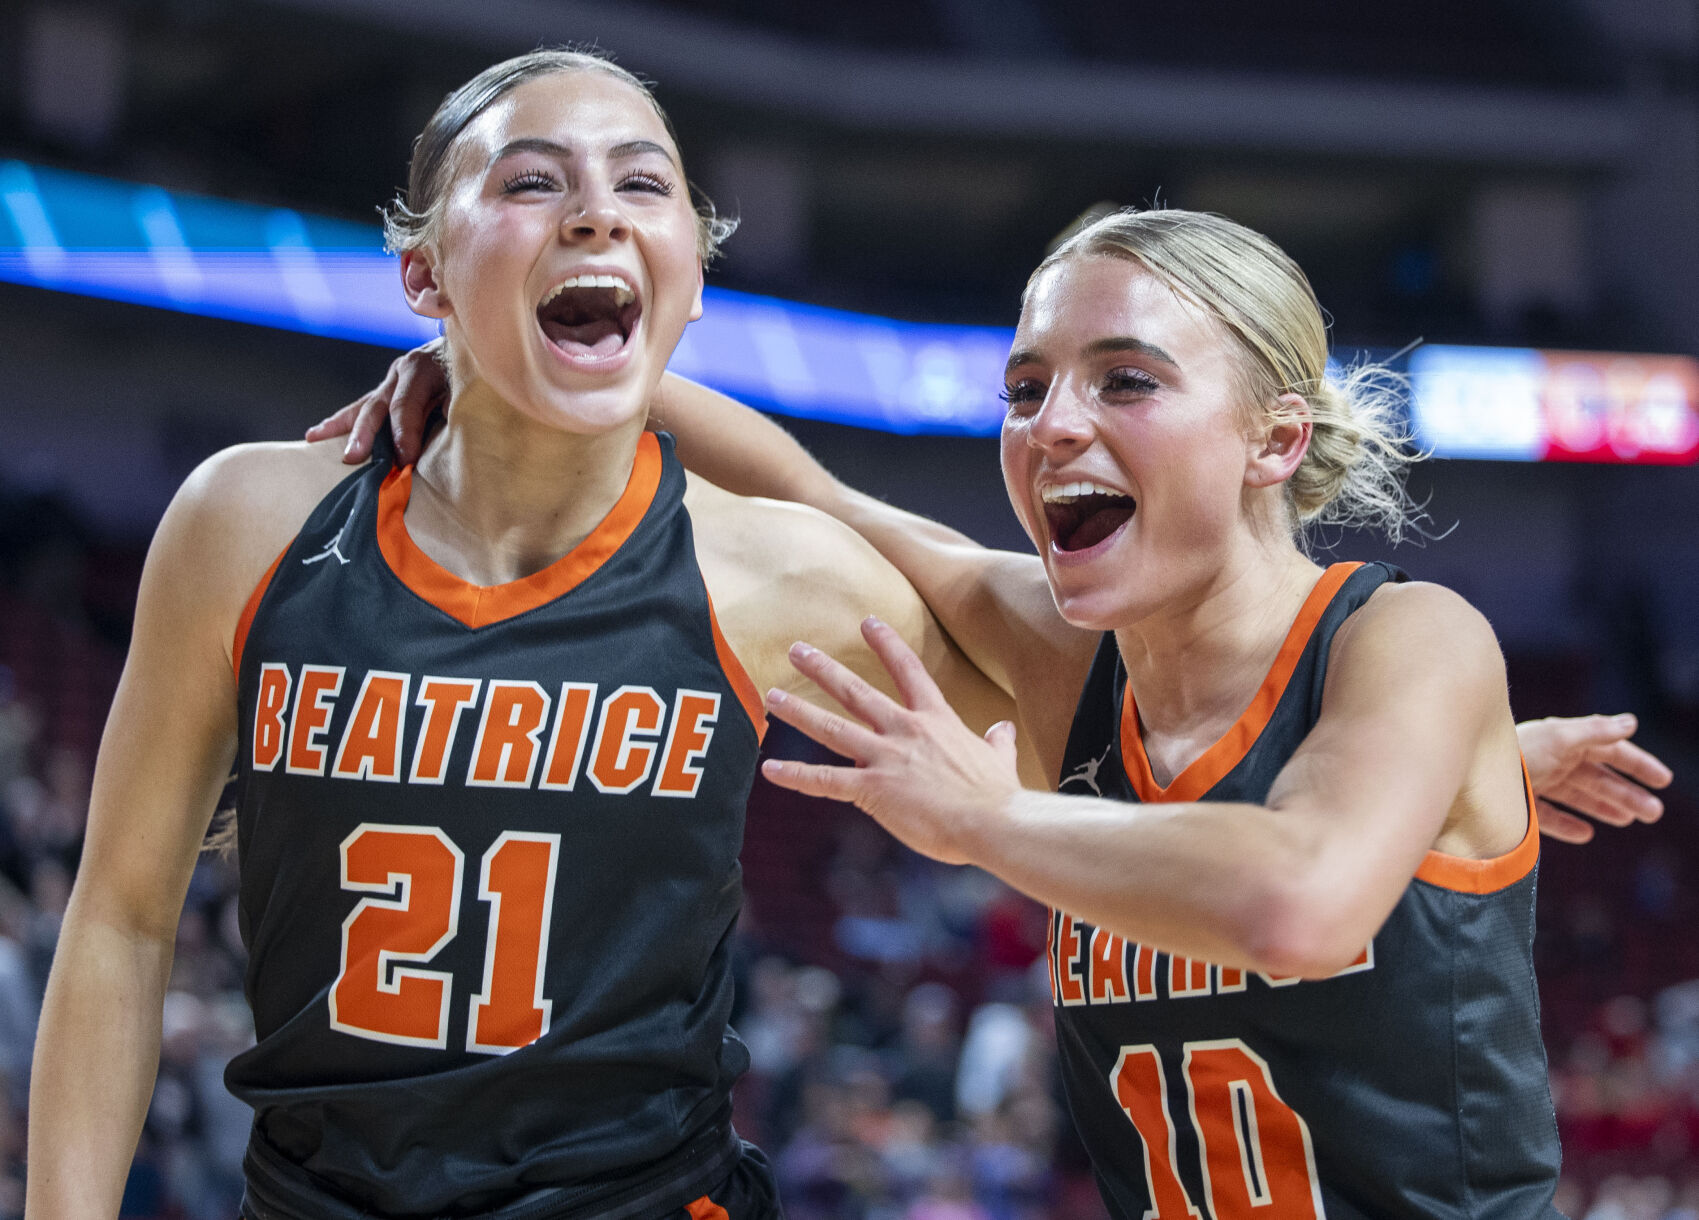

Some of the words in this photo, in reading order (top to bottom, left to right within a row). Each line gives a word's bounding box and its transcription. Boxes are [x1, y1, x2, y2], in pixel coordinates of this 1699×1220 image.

[253, 662, 721, 798] BEATRICE
[328, 822, 561, 1056] 21
[1109, 1038, 1327, 1220] 10
